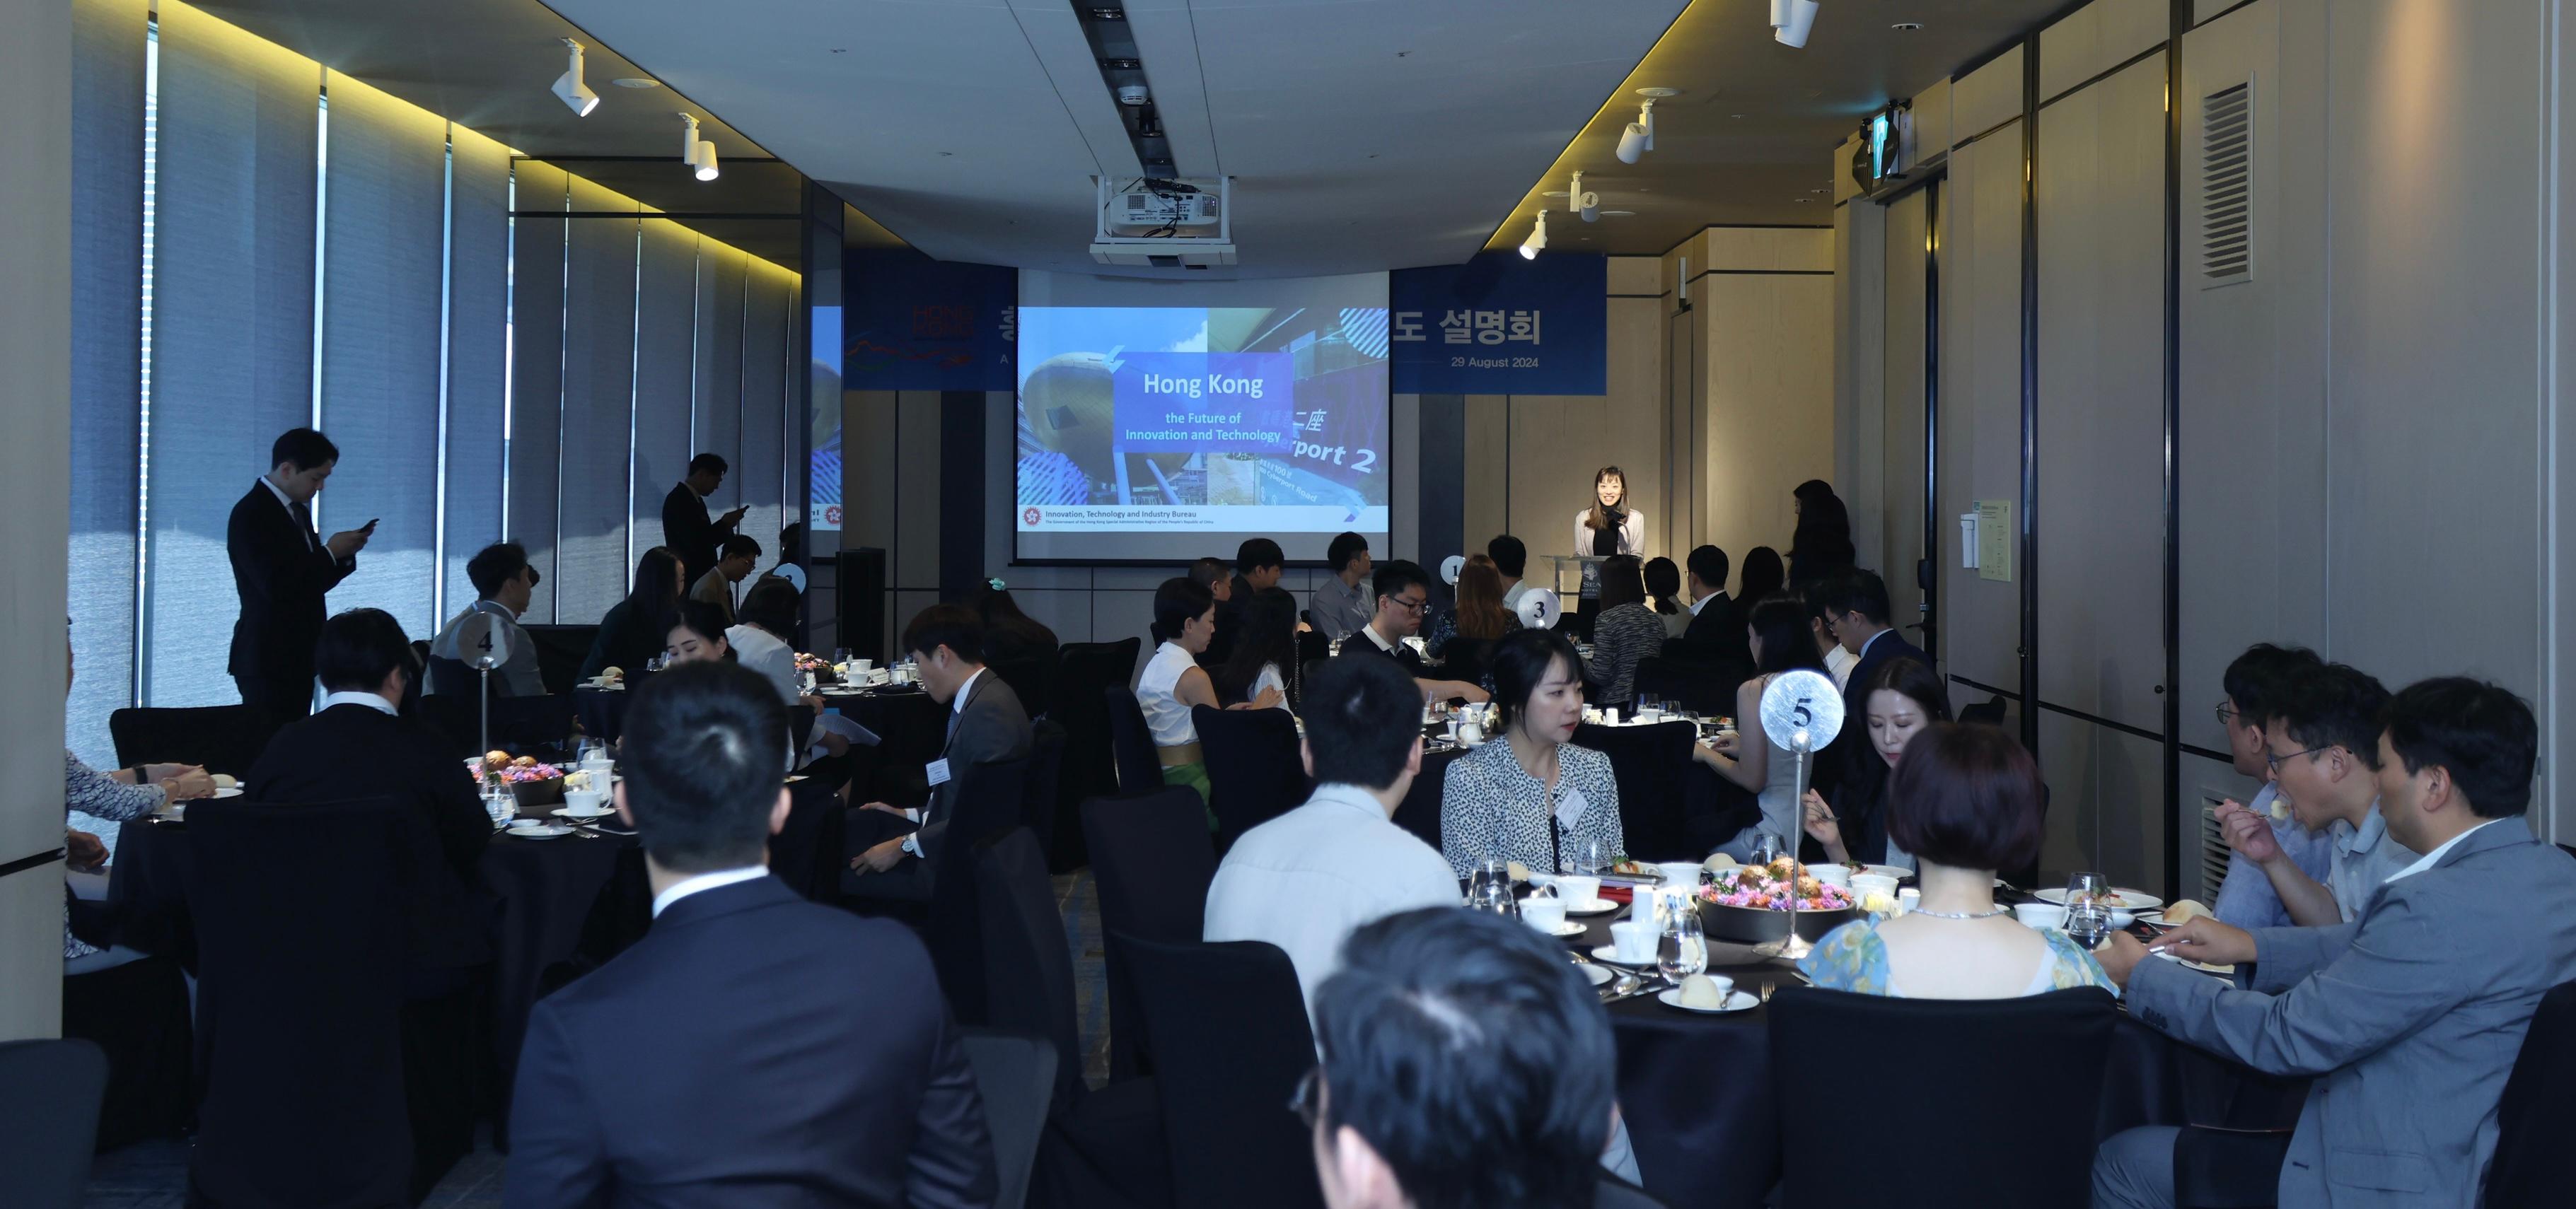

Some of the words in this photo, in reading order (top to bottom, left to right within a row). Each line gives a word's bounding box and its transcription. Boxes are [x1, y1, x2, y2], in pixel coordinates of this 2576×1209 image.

[1439, 309, 1540, 345] 설명회
[1451, 357, 1465, 368] 29
[1468, 356, 1509, 368] August
[1512, 357, 1539, 368] 2024
[1144, 373, 1202, 399] Hong
[1208, 373, 1263, 399] Kong
[1165, 412, 1186, 424] the
[1189, 413, 1226, 424] Future
[1229, 412, 1242, 424] of
[1125, 429, 1189, 440] Innovation
[1191, 429, 1213, 440] and
[1216, 429, 1281, 443] Technology
[1351, 449, 1376, 474] 2
[1296, 486, 1318, 503] Road
[1086, 510, 1125, 519] Technology
[1452, 565, 1458, 577] 1
[1533, 601, 1545, 619] 3
[477, 631, 493, 652] 4
[1793, 698, 1812, 727] 5
